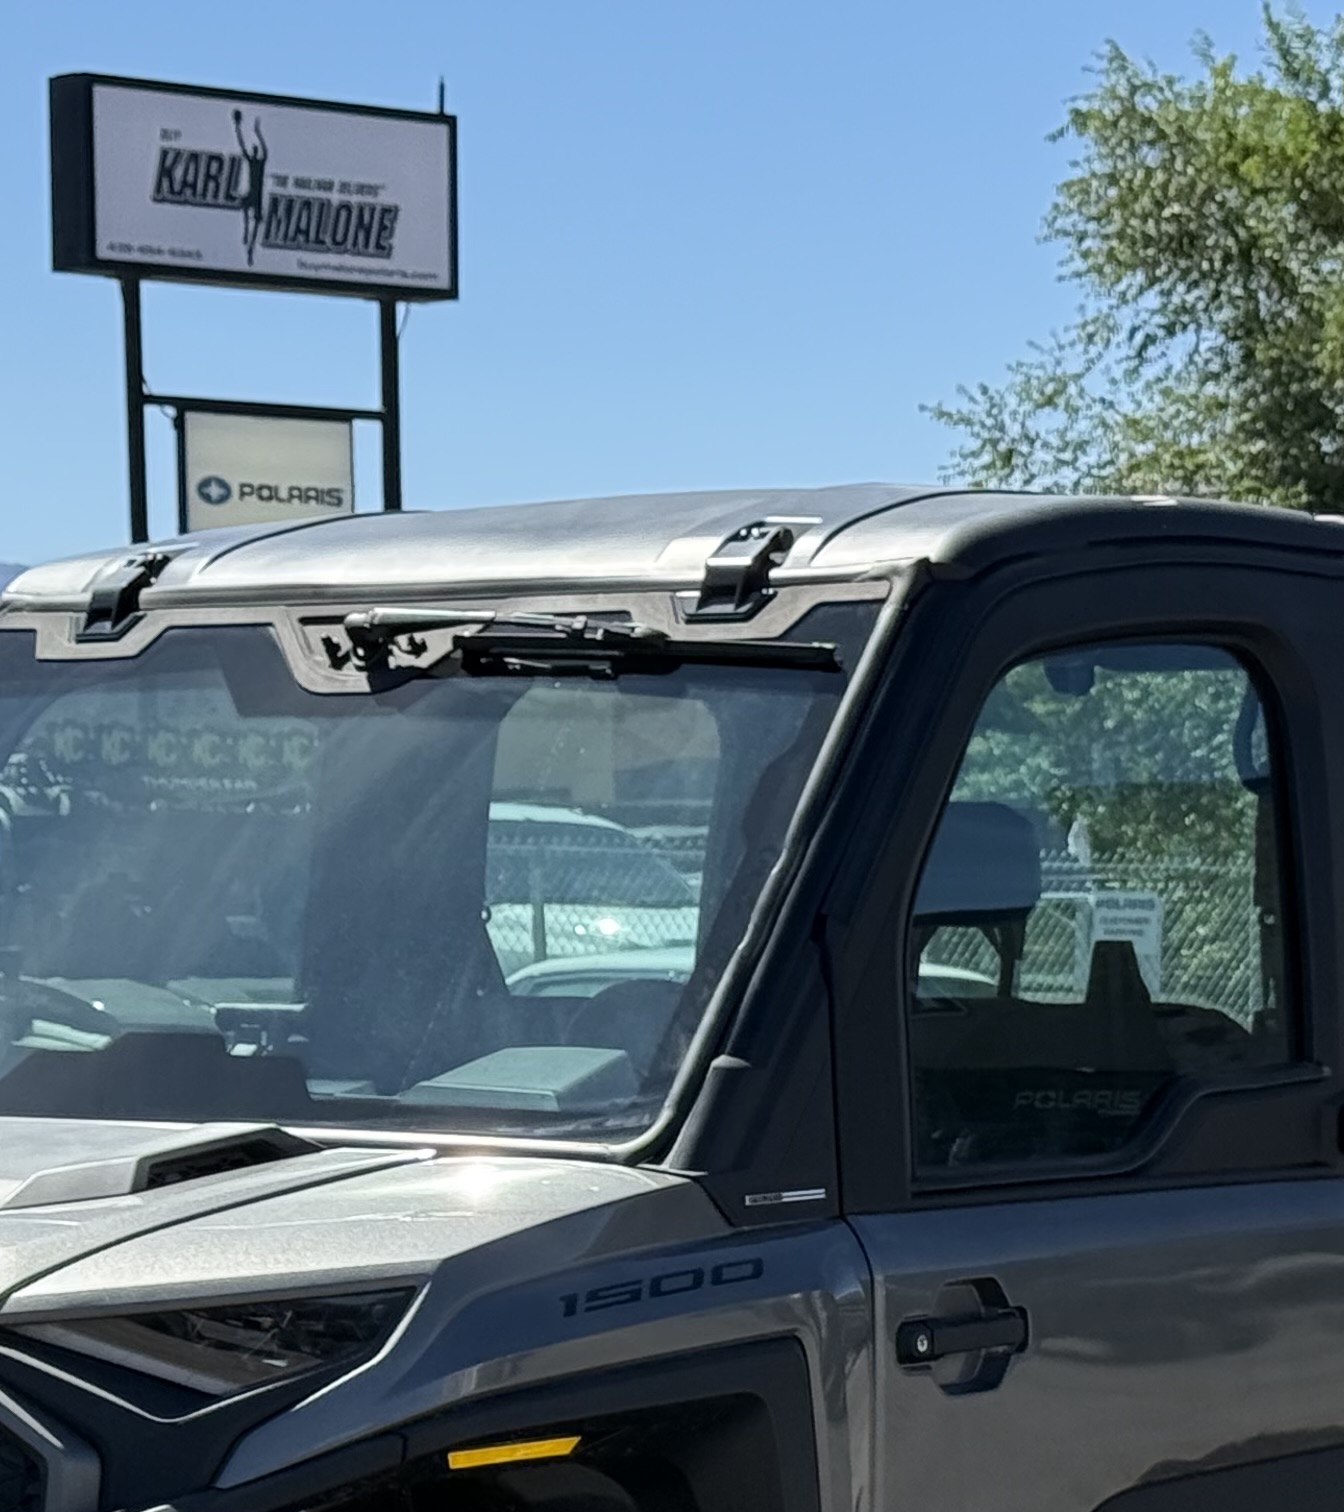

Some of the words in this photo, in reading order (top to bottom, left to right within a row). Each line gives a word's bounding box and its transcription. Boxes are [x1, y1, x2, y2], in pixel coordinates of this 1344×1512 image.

[151, 147, 244, 210] KARL
[261, 193, 400, 259] MALONE
[239, 482, 344, 507] POLARIS
[1013, 1089, 1143, 1110] POLARIS
[559, 1257, 765, 1318] 1500
